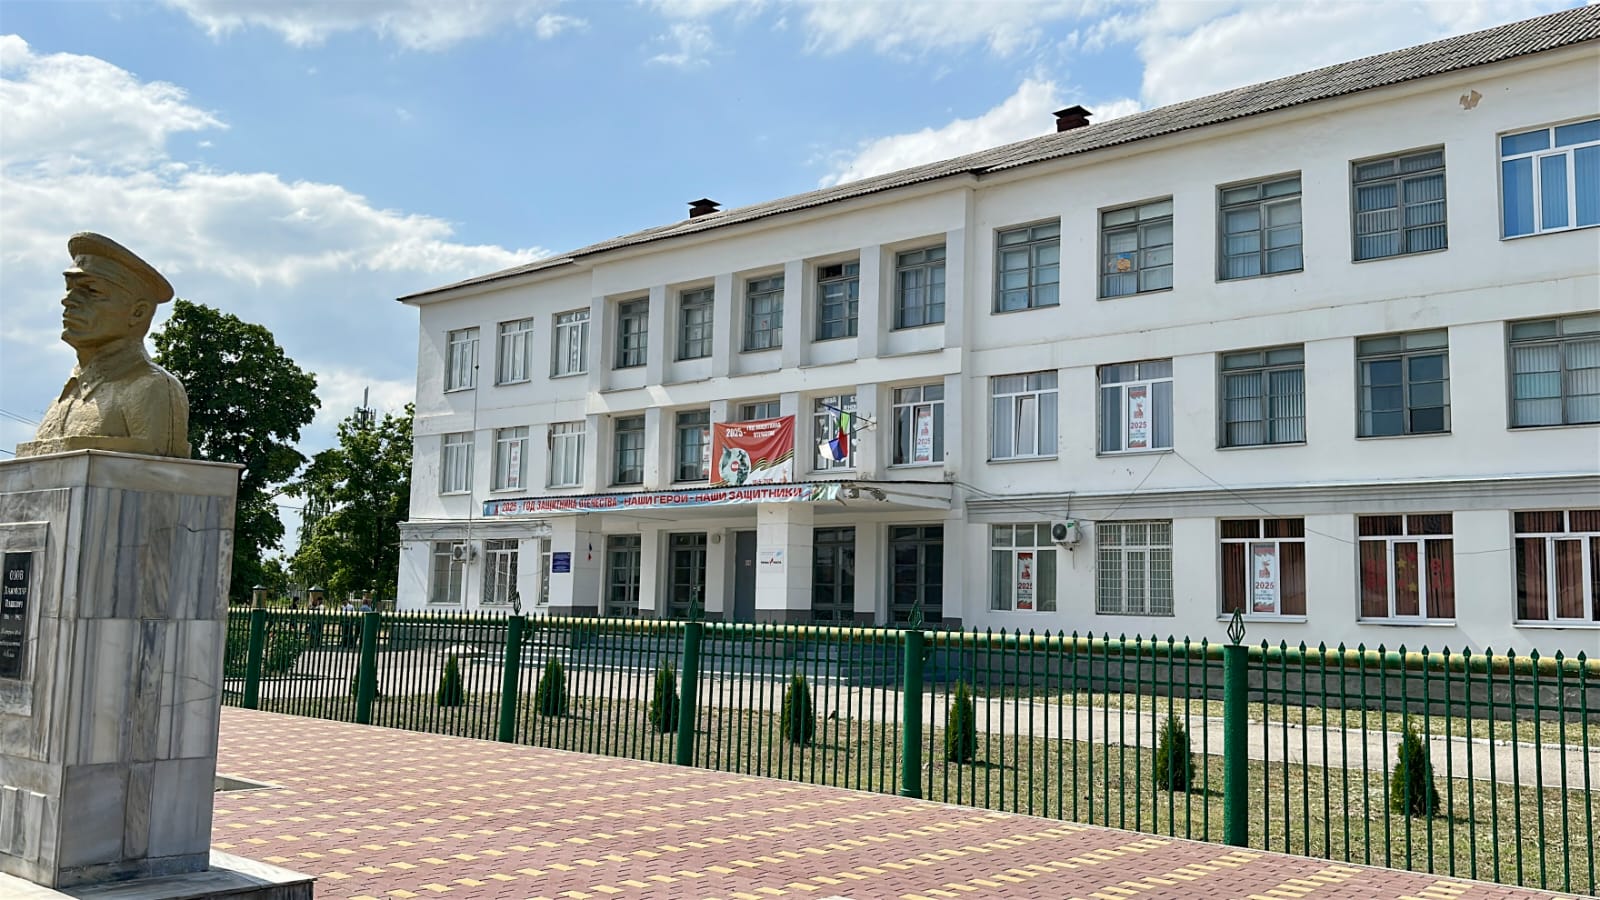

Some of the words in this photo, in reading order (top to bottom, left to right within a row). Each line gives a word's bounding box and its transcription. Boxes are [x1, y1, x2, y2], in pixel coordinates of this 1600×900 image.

[726, 428, 743, 438] 2025
[502, 502, 517, 512] 2025
[523, 500, 535, 512] ГОД
[537, 499, 577, 511] ЗАЩИТНИКА
[579, 497, 617, 508] ОТЕЧЕСТВА
[624, 496, 652, 506] НАШИ
[695, 492, 727, 502] НАШИ
[729, 487, 802, 501] ЗАЩИТНИКИ
